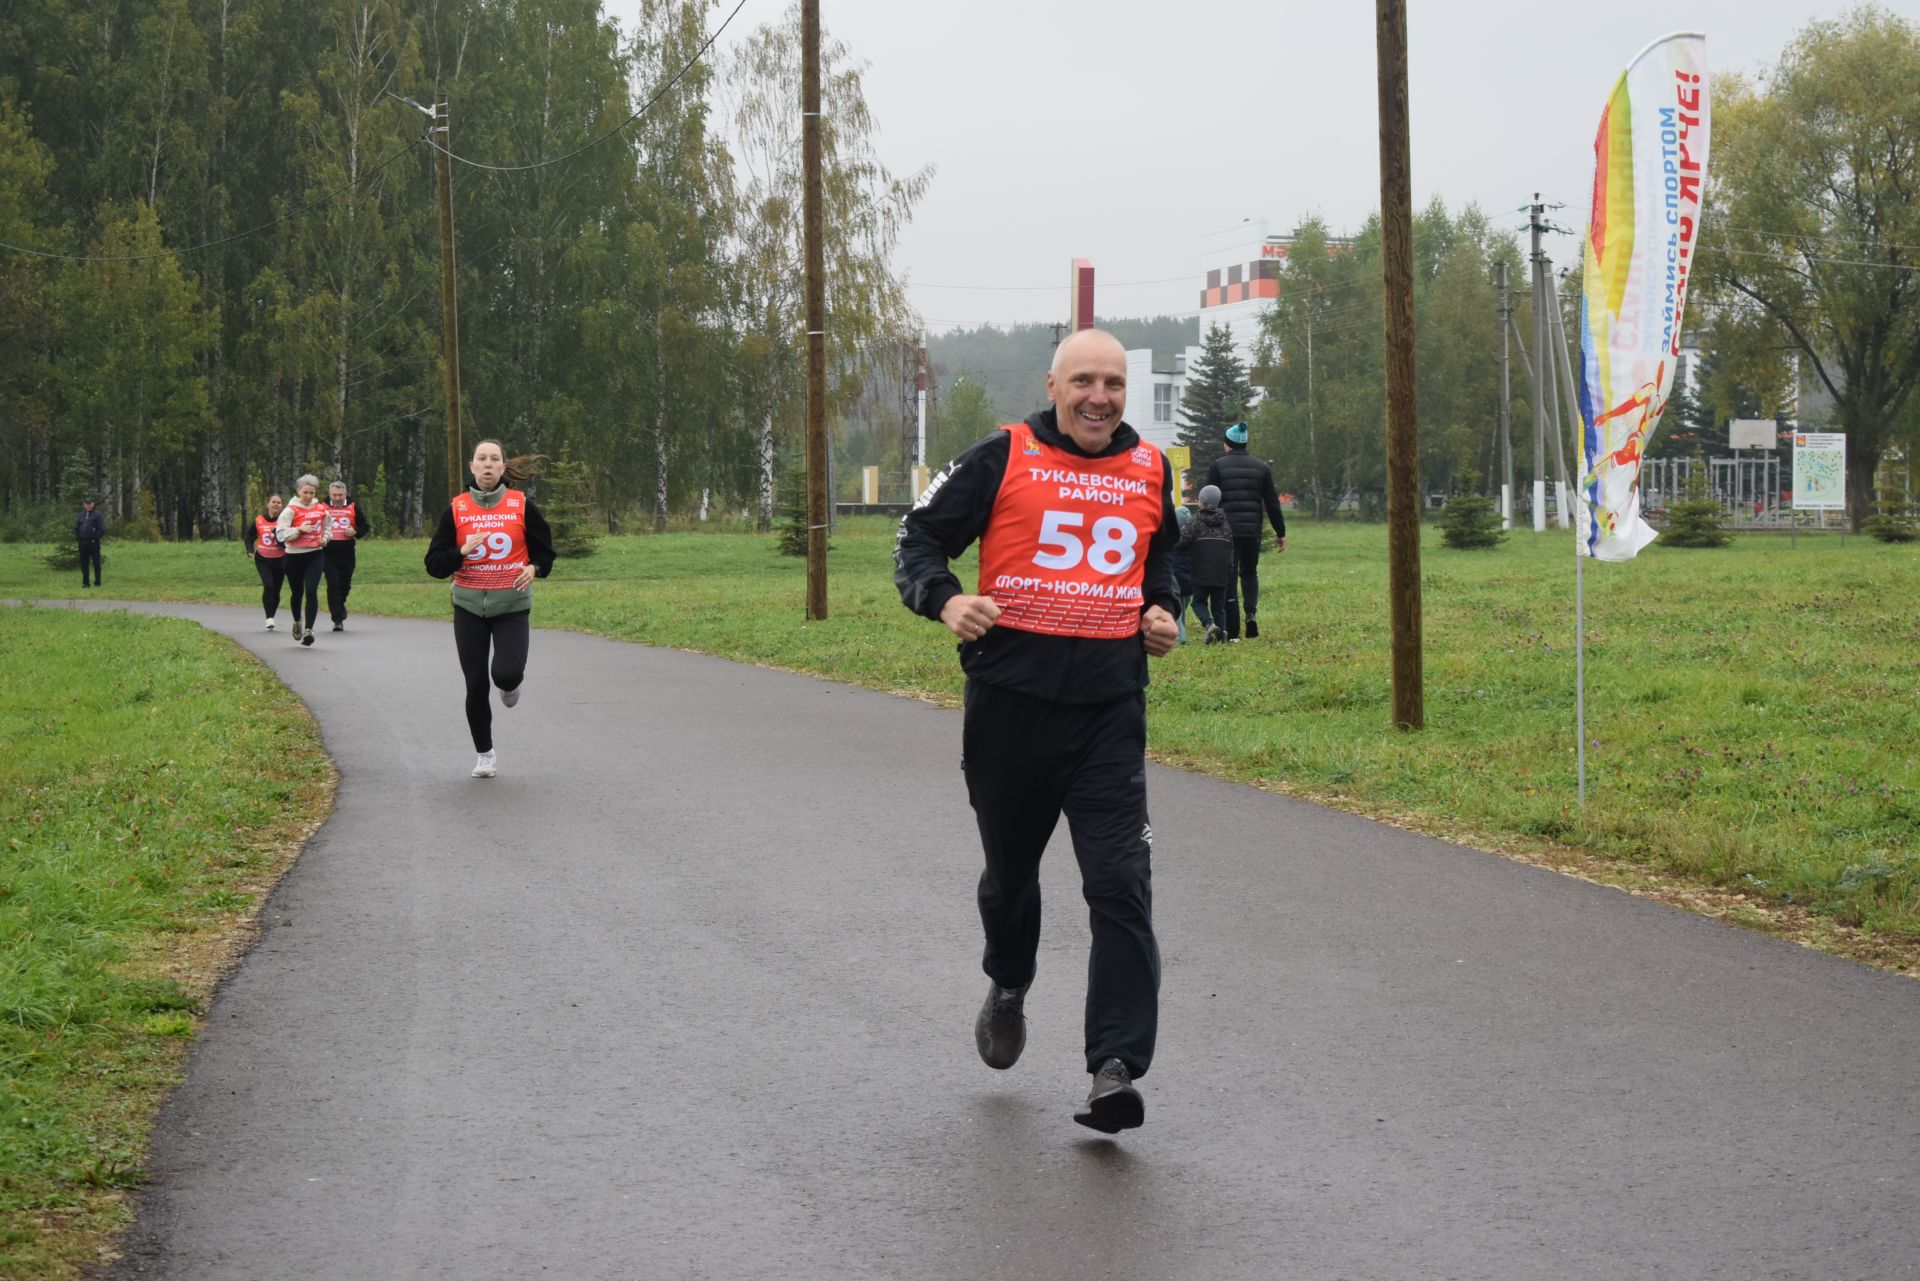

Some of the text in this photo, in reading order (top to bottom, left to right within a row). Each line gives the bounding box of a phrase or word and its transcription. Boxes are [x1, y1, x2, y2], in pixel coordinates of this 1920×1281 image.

[1675, 70, 1699, 204] ЯРЧЕ!
[1659, 108, 1678, 353] ЗАЙМИСЬ СПОРТОМ
[1029, 468, 1148, 495] ТУКАЕВСКИЙ
[1059, 486, 1125, 505] РАЙОН
[460, 513, 517, 522] ТУКАЕВСКИЙ
[472, 521, 504, 529] РАЙОН
[1032, 509, 1138, 575] 58
[996, 575, 1041, 591] СПОРТ
[1054, 580, 1113, 598] НОРМА
